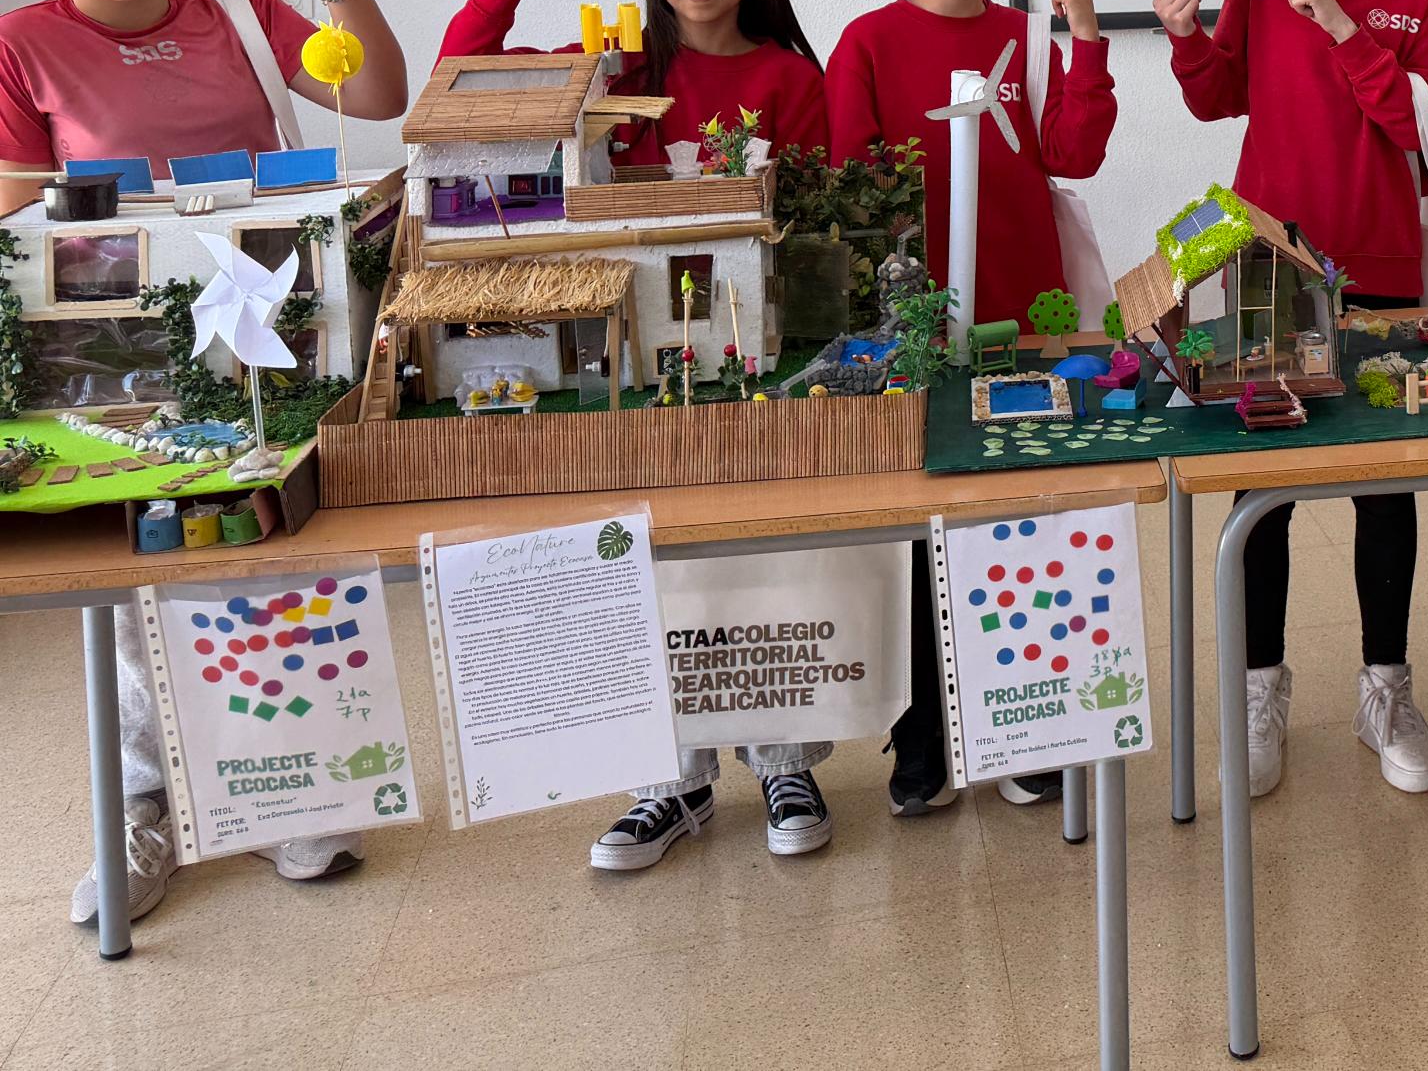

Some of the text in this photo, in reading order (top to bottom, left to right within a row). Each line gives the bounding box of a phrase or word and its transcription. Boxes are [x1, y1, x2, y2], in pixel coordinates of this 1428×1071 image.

[1389, 14, 1421, 33] SDS
[666, 621, 835, 650] CTAACOLEGIO
[983, 677, 1071, 707] PROJECTE
[991, 701, 1068, 727] ECOCASA
[216, 752, 318, 777] PROJECTE
[227, 772, 315, 797] ECOCASA
